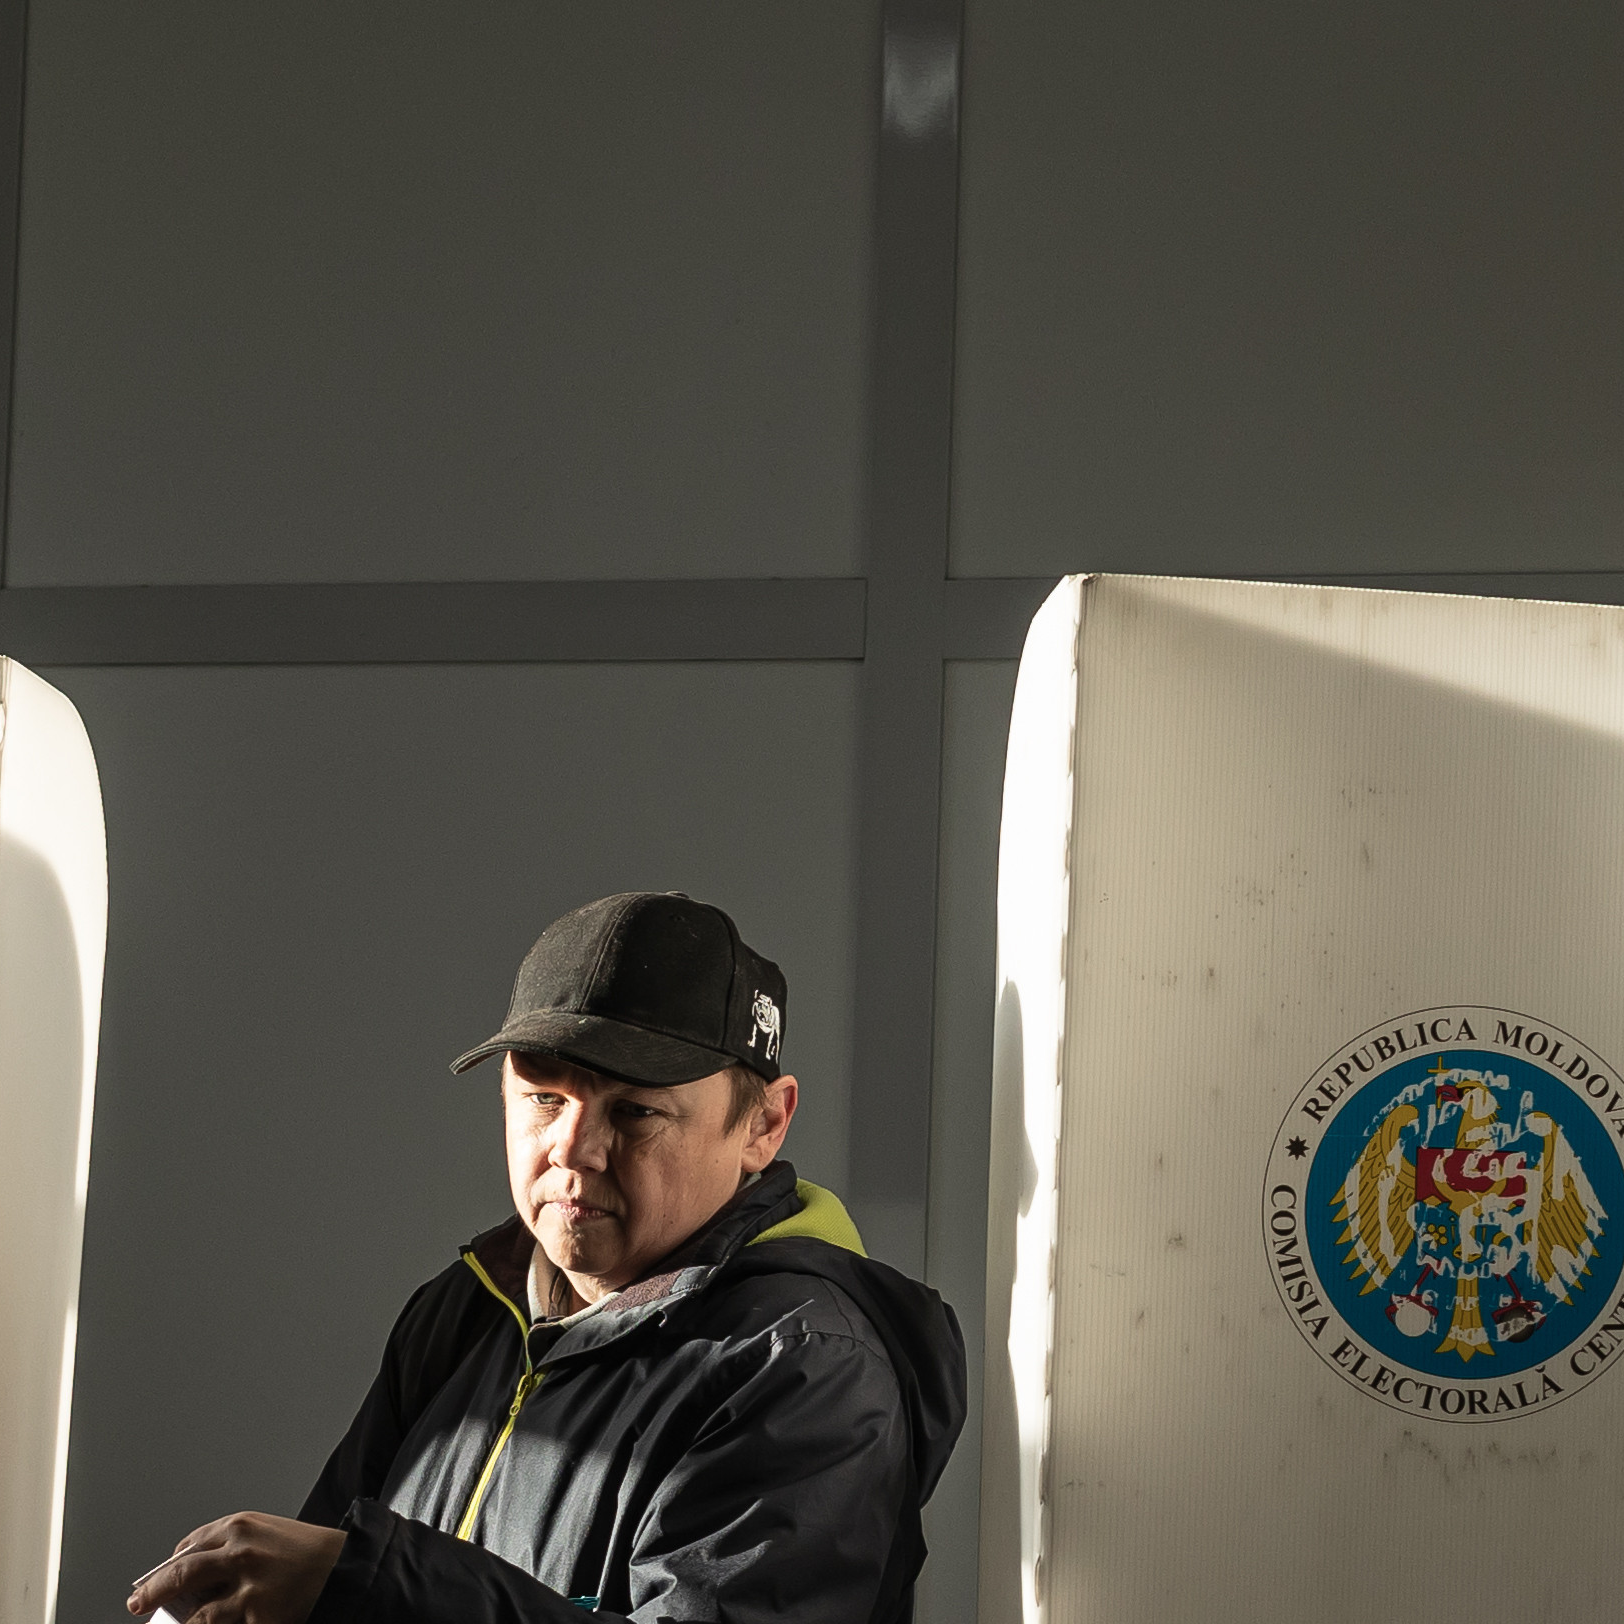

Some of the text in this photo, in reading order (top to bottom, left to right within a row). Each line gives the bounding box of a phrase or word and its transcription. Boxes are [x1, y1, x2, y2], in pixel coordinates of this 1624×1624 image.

[1300, 1017, 1477, 1124] REPUBLICA
[1269, 1184, 1333, 1341] COMISIA
[1328, 1335, 1565, 1416] ELECTORALĂ
